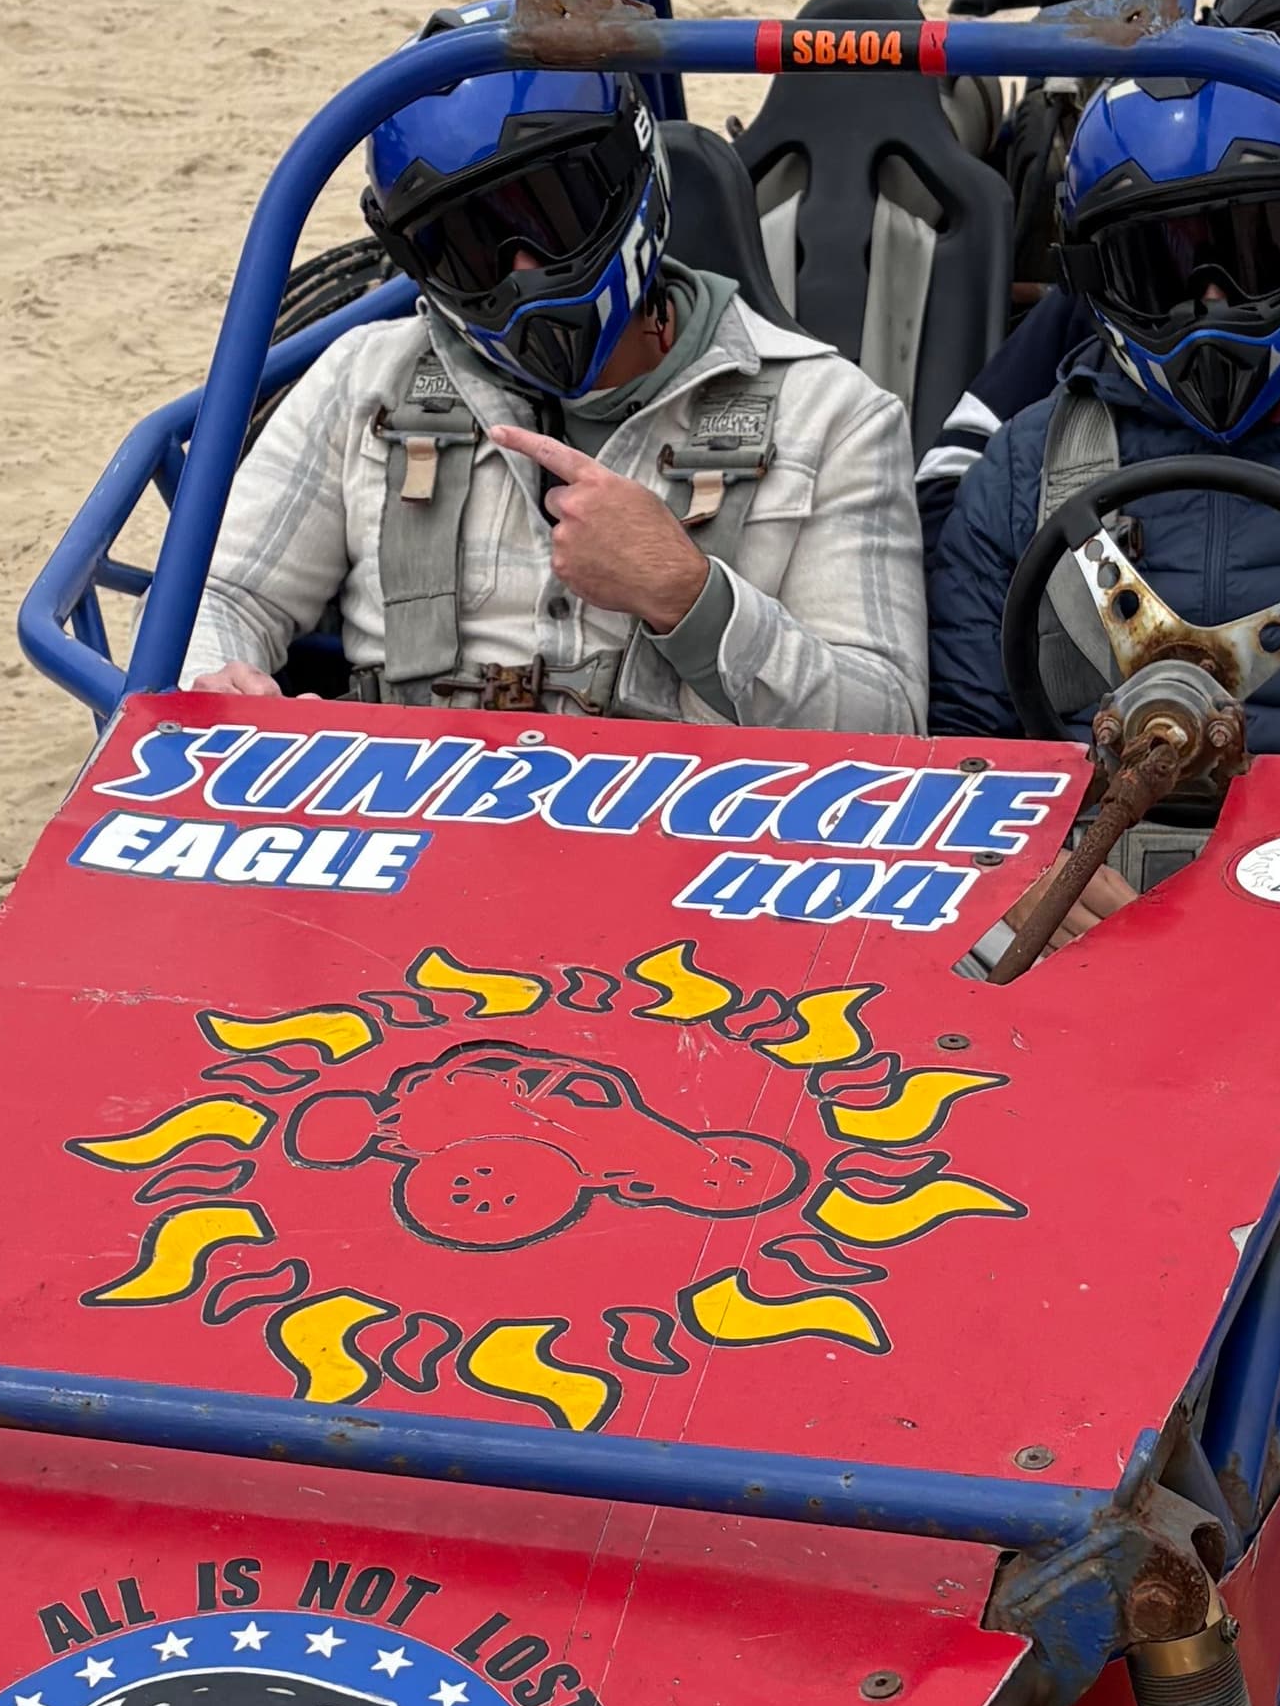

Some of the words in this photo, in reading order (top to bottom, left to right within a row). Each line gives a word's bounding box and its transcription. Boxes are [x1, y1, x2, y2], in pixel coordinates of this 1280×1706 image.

[793, 29, 902, 65] SB404
[95, 726, 1075, 854] SUNBUGGIE
[73, 813, 426, 890] EAGLE
[674, 853, 975, 931] 404
[38, 1574, 157, 1654] ALL
[197, 1557, 263, 1612] IS
[299, 1559, 443, 1631] NOT
